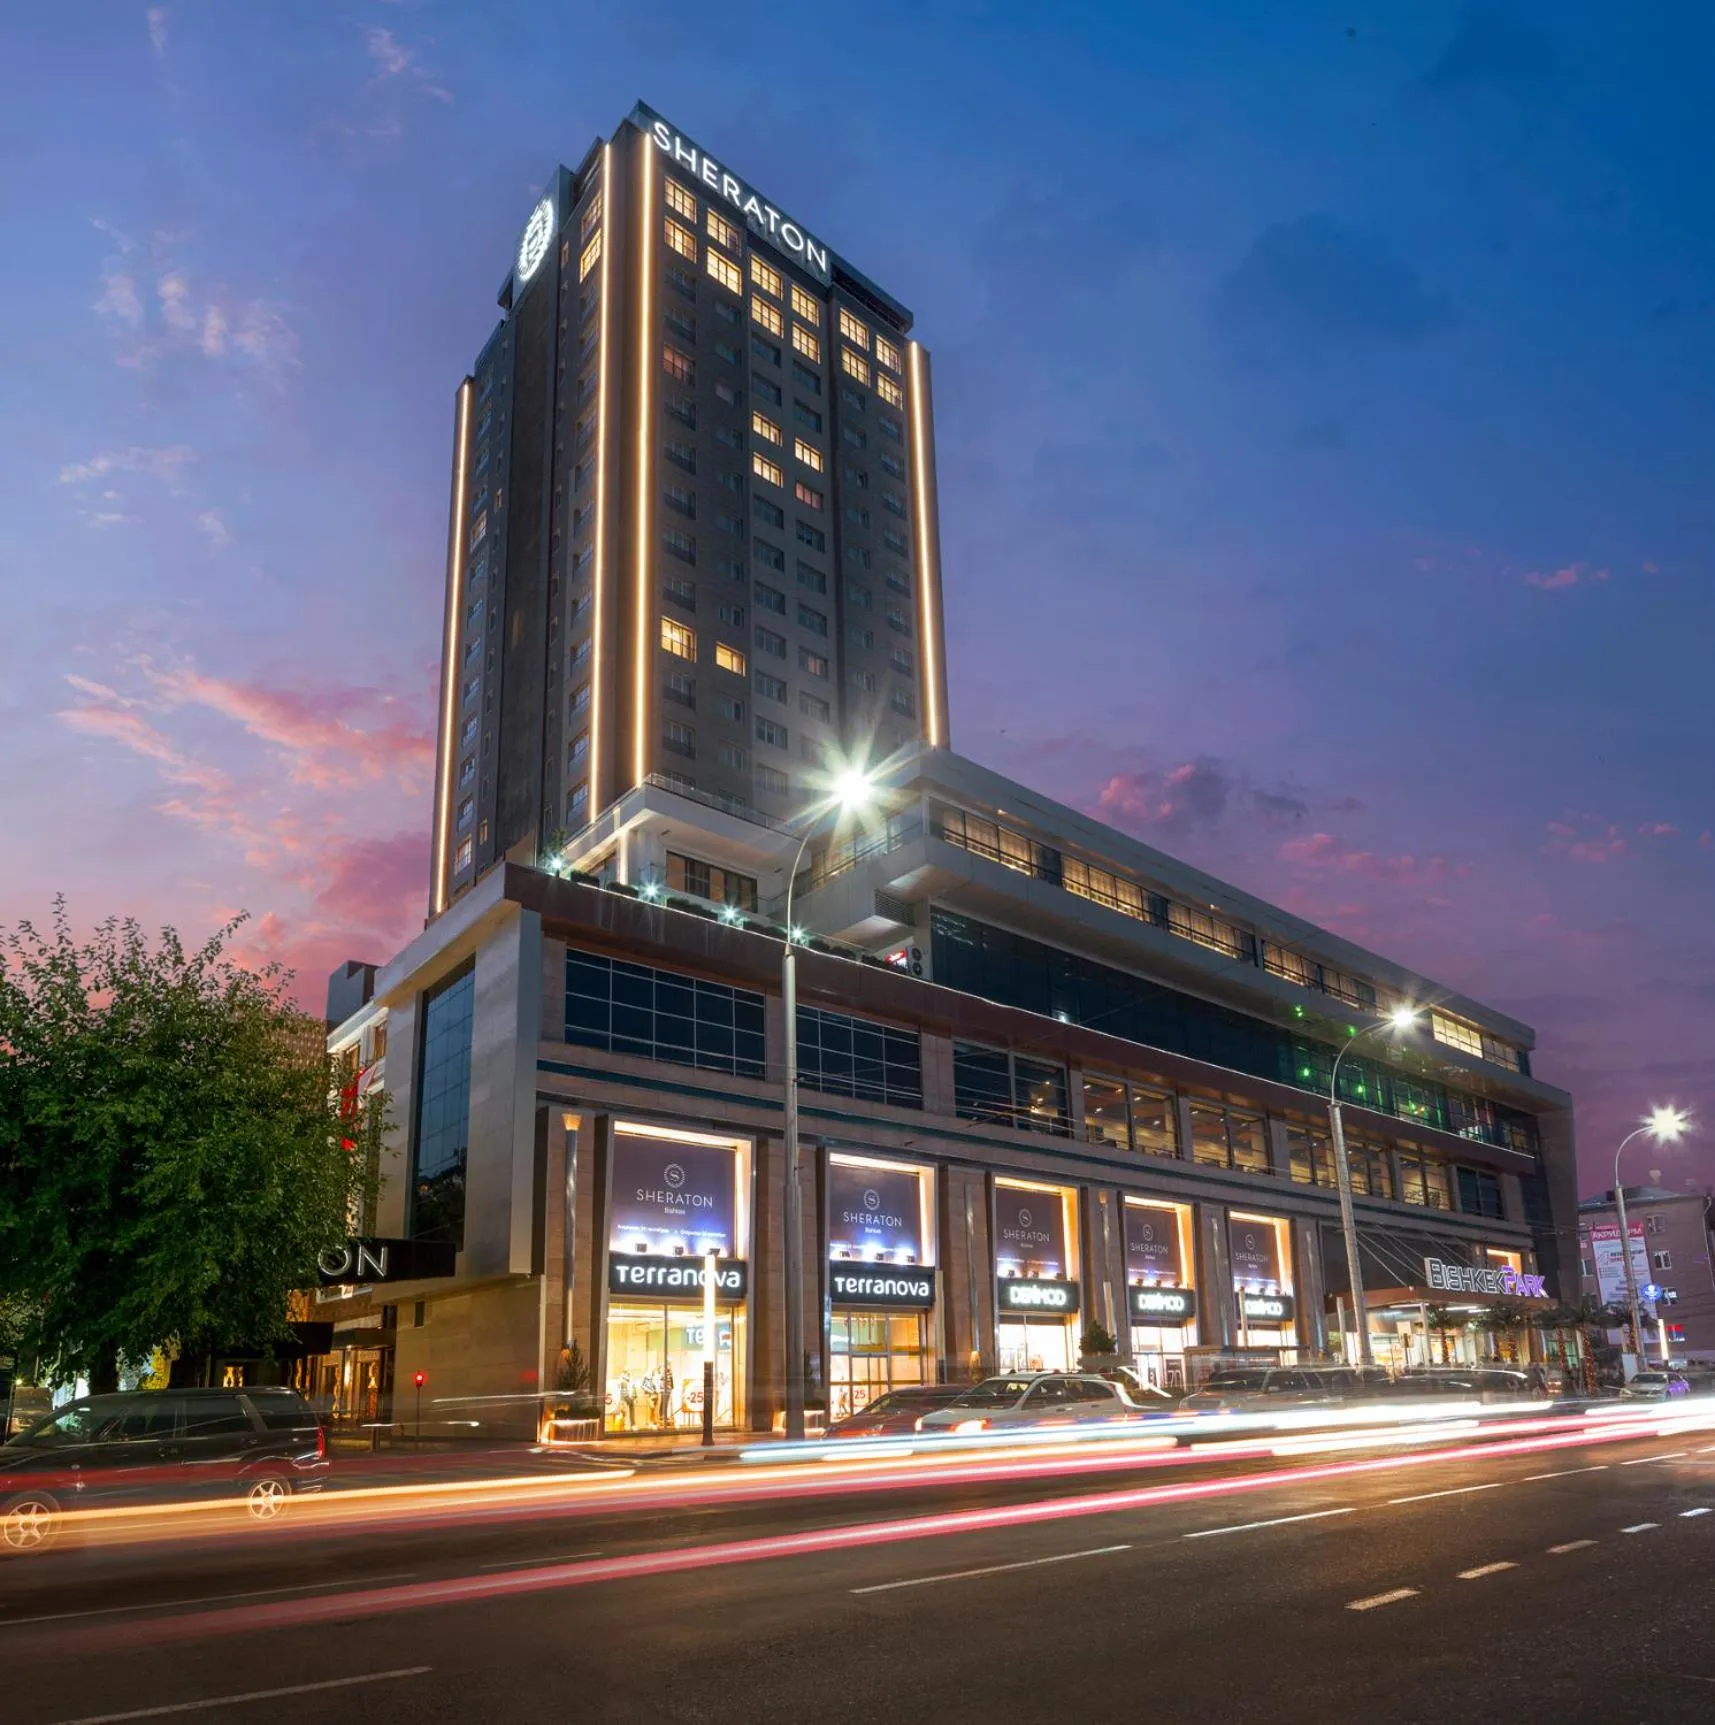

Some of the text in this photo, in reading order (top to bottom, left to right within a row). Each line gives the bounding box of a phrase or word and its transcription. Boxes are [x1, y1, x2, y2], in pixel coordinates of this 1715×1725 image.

[653, 121, 826, 272] SHERATON
[635, 1188, 713, 1208] SHERATON
[842, 1211, 902, 1227] SHERATON
[1003, 1228, 1050, 1243] SHERATON
[1130, 1242, 1169, 1256] SHERATON
